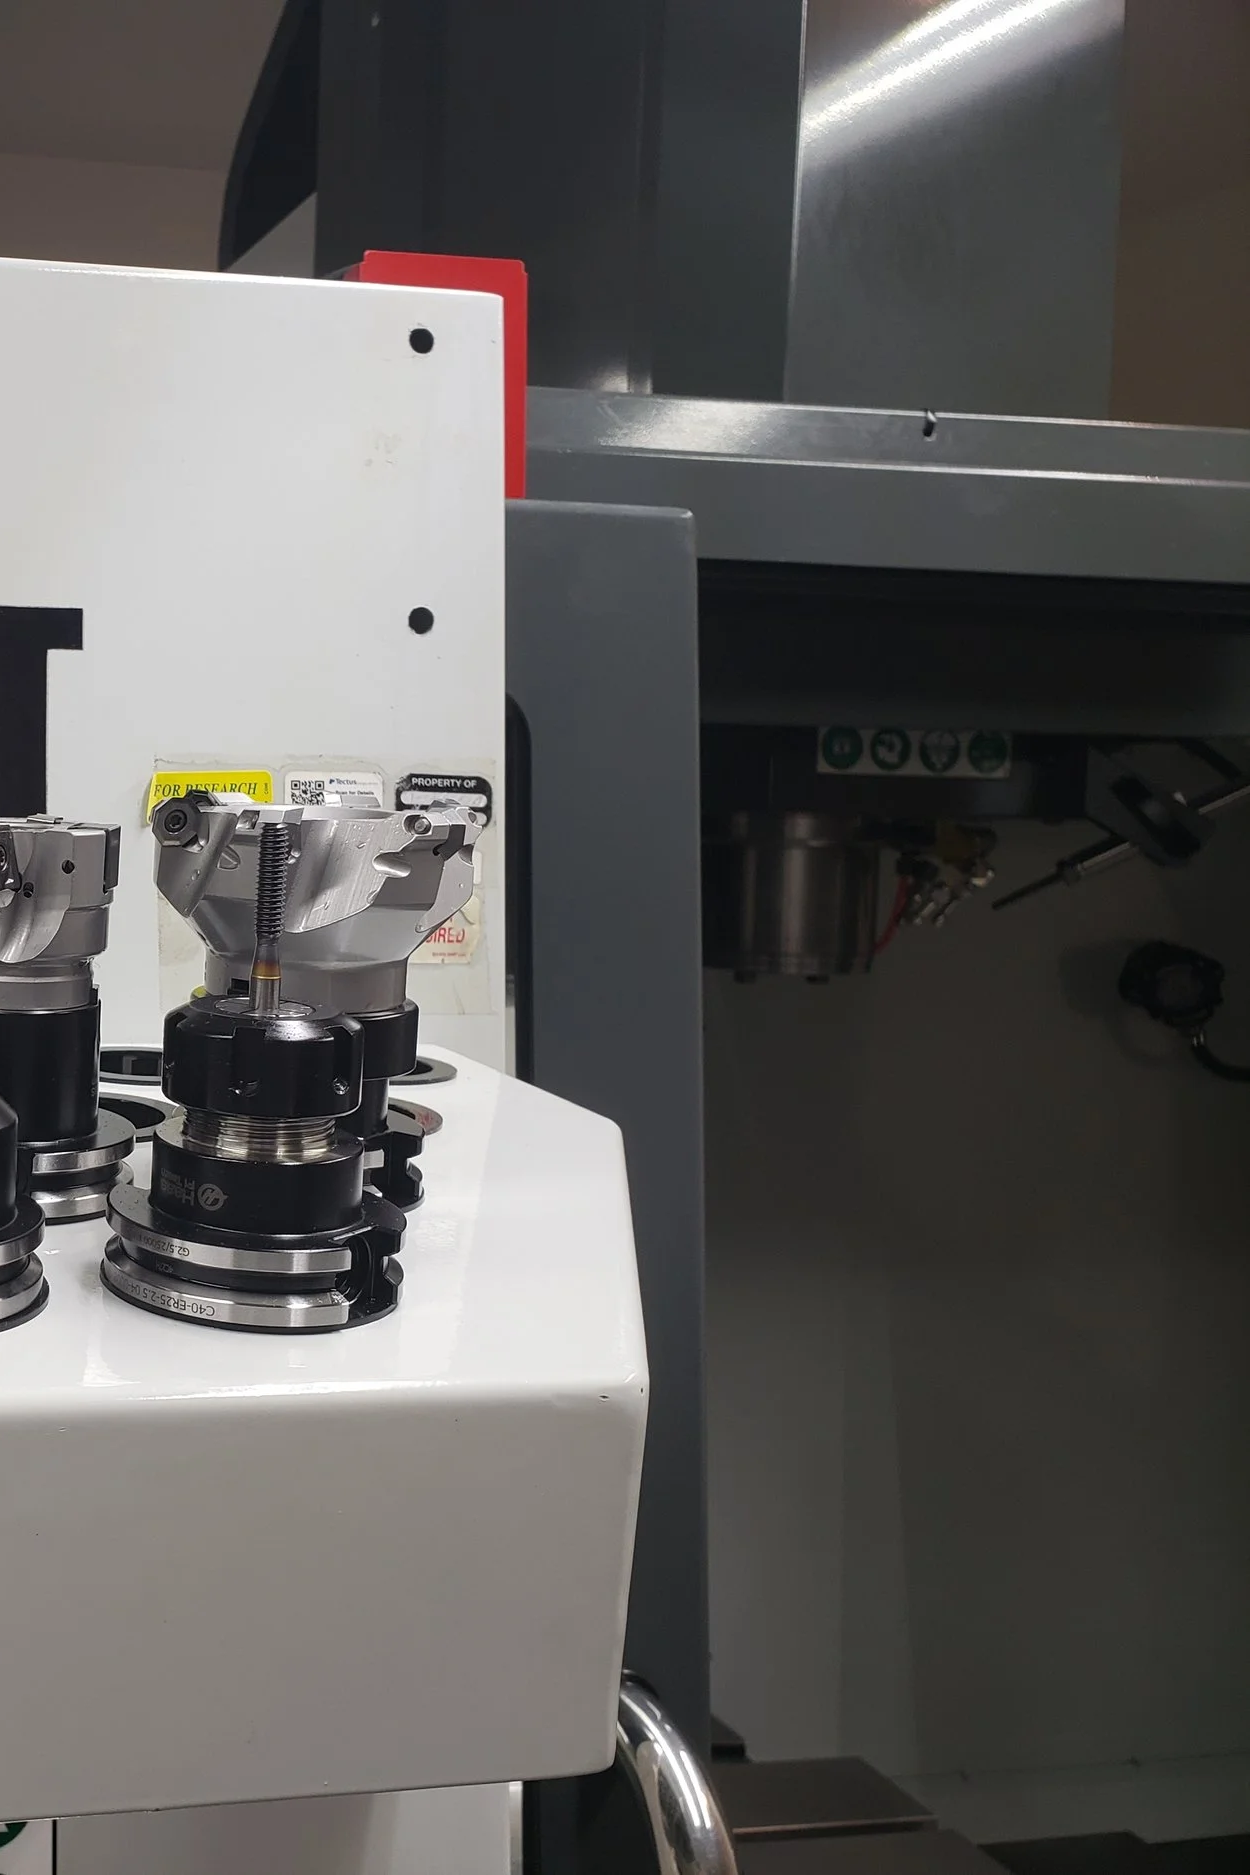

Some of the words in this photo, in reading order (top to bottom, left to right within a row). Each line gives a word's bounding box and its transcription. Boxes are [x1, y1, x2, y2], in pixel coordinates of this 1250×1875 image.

[411, 777, 462, 788] PROPERTY
[463, 779, 477, 788] OF
[153, 783, 181, 797] FOR
[142, 1287, 216, 1317] C40-ER25-2.5
